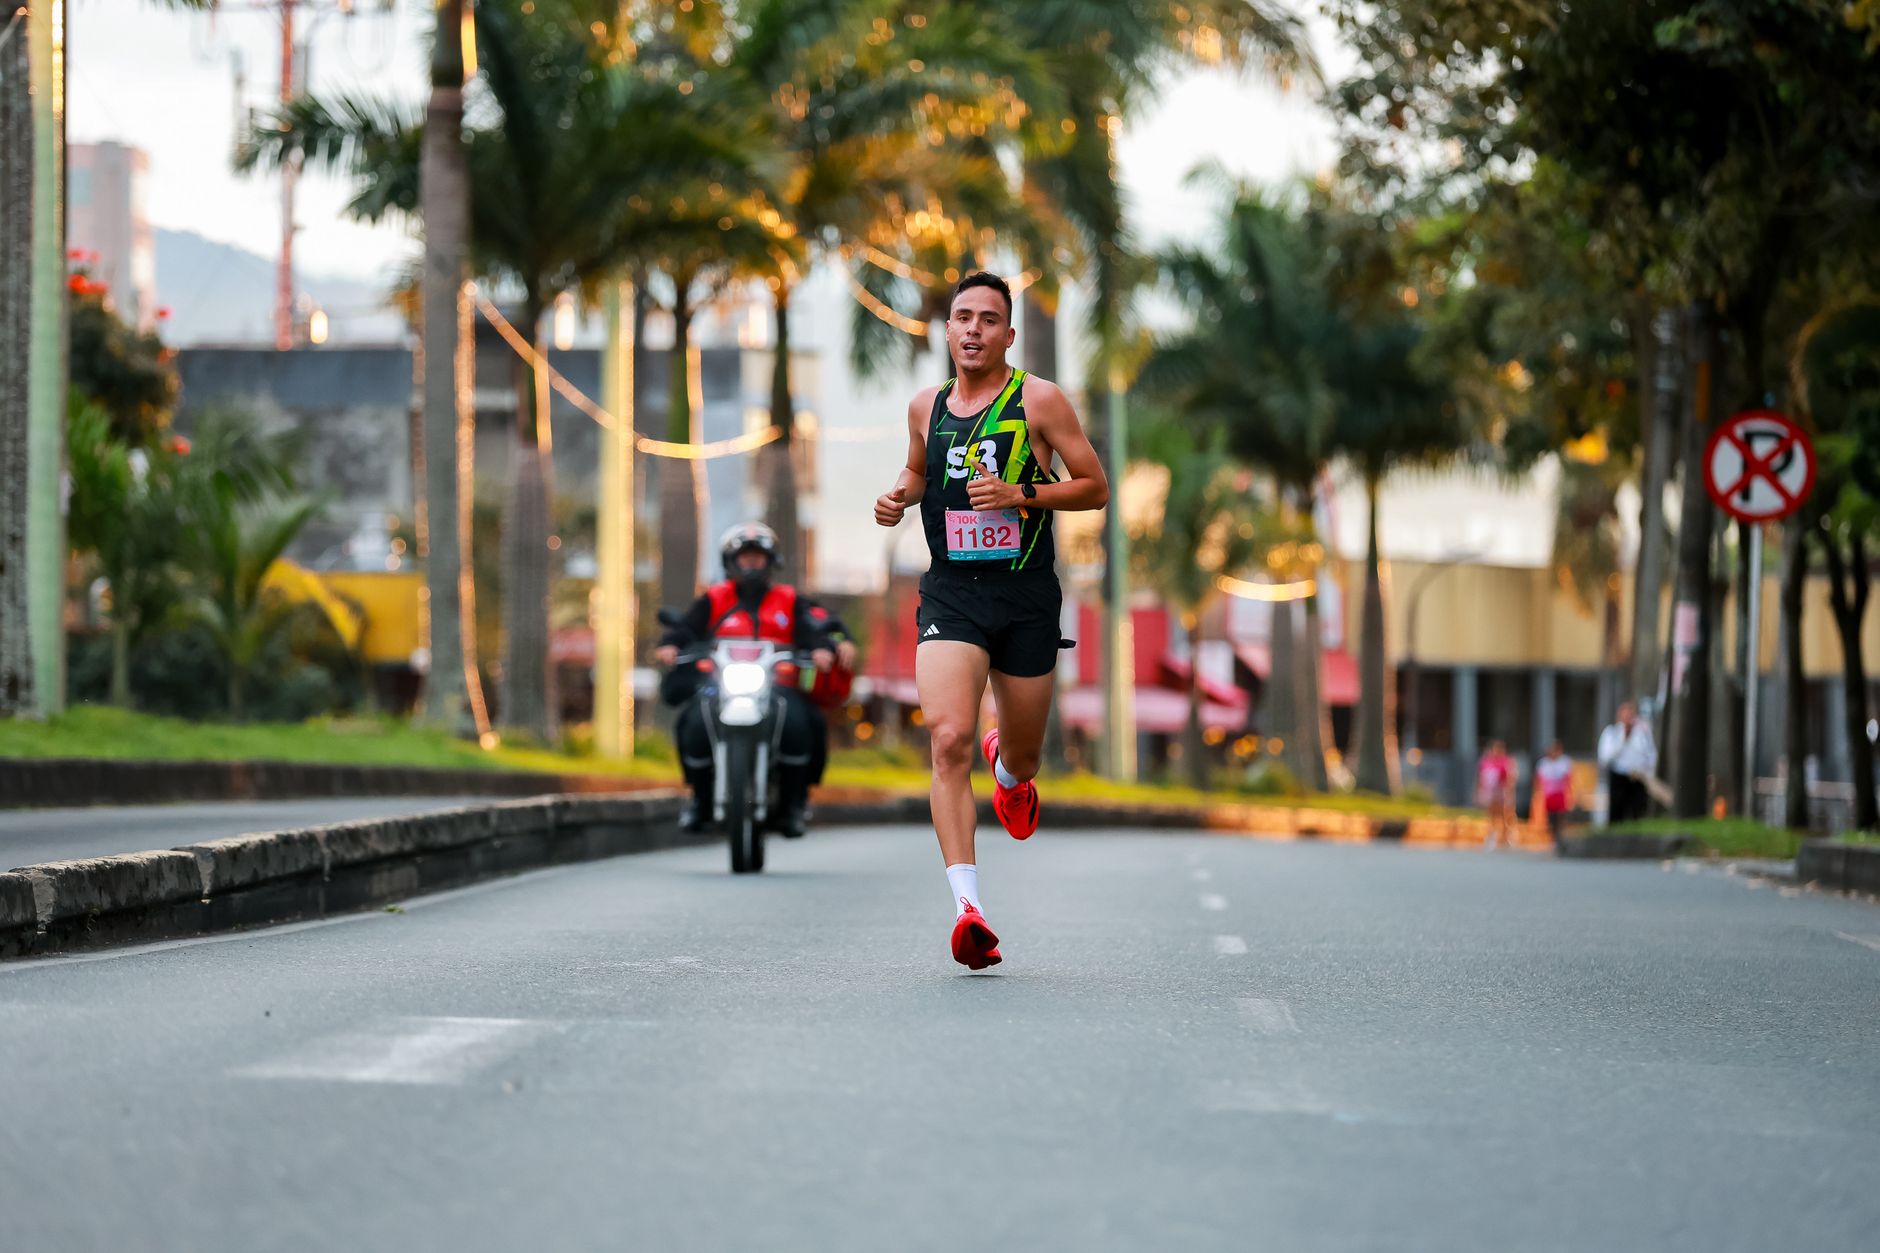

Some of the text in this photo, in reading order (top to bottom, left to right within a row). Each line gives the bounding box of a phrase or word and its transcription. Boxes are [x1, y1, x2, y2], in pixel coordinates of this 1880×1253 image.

[1741, 430, 1794, 502] P
[956, 515, 978, 525] 10K
[954, 525, 1012, 549] 1182
